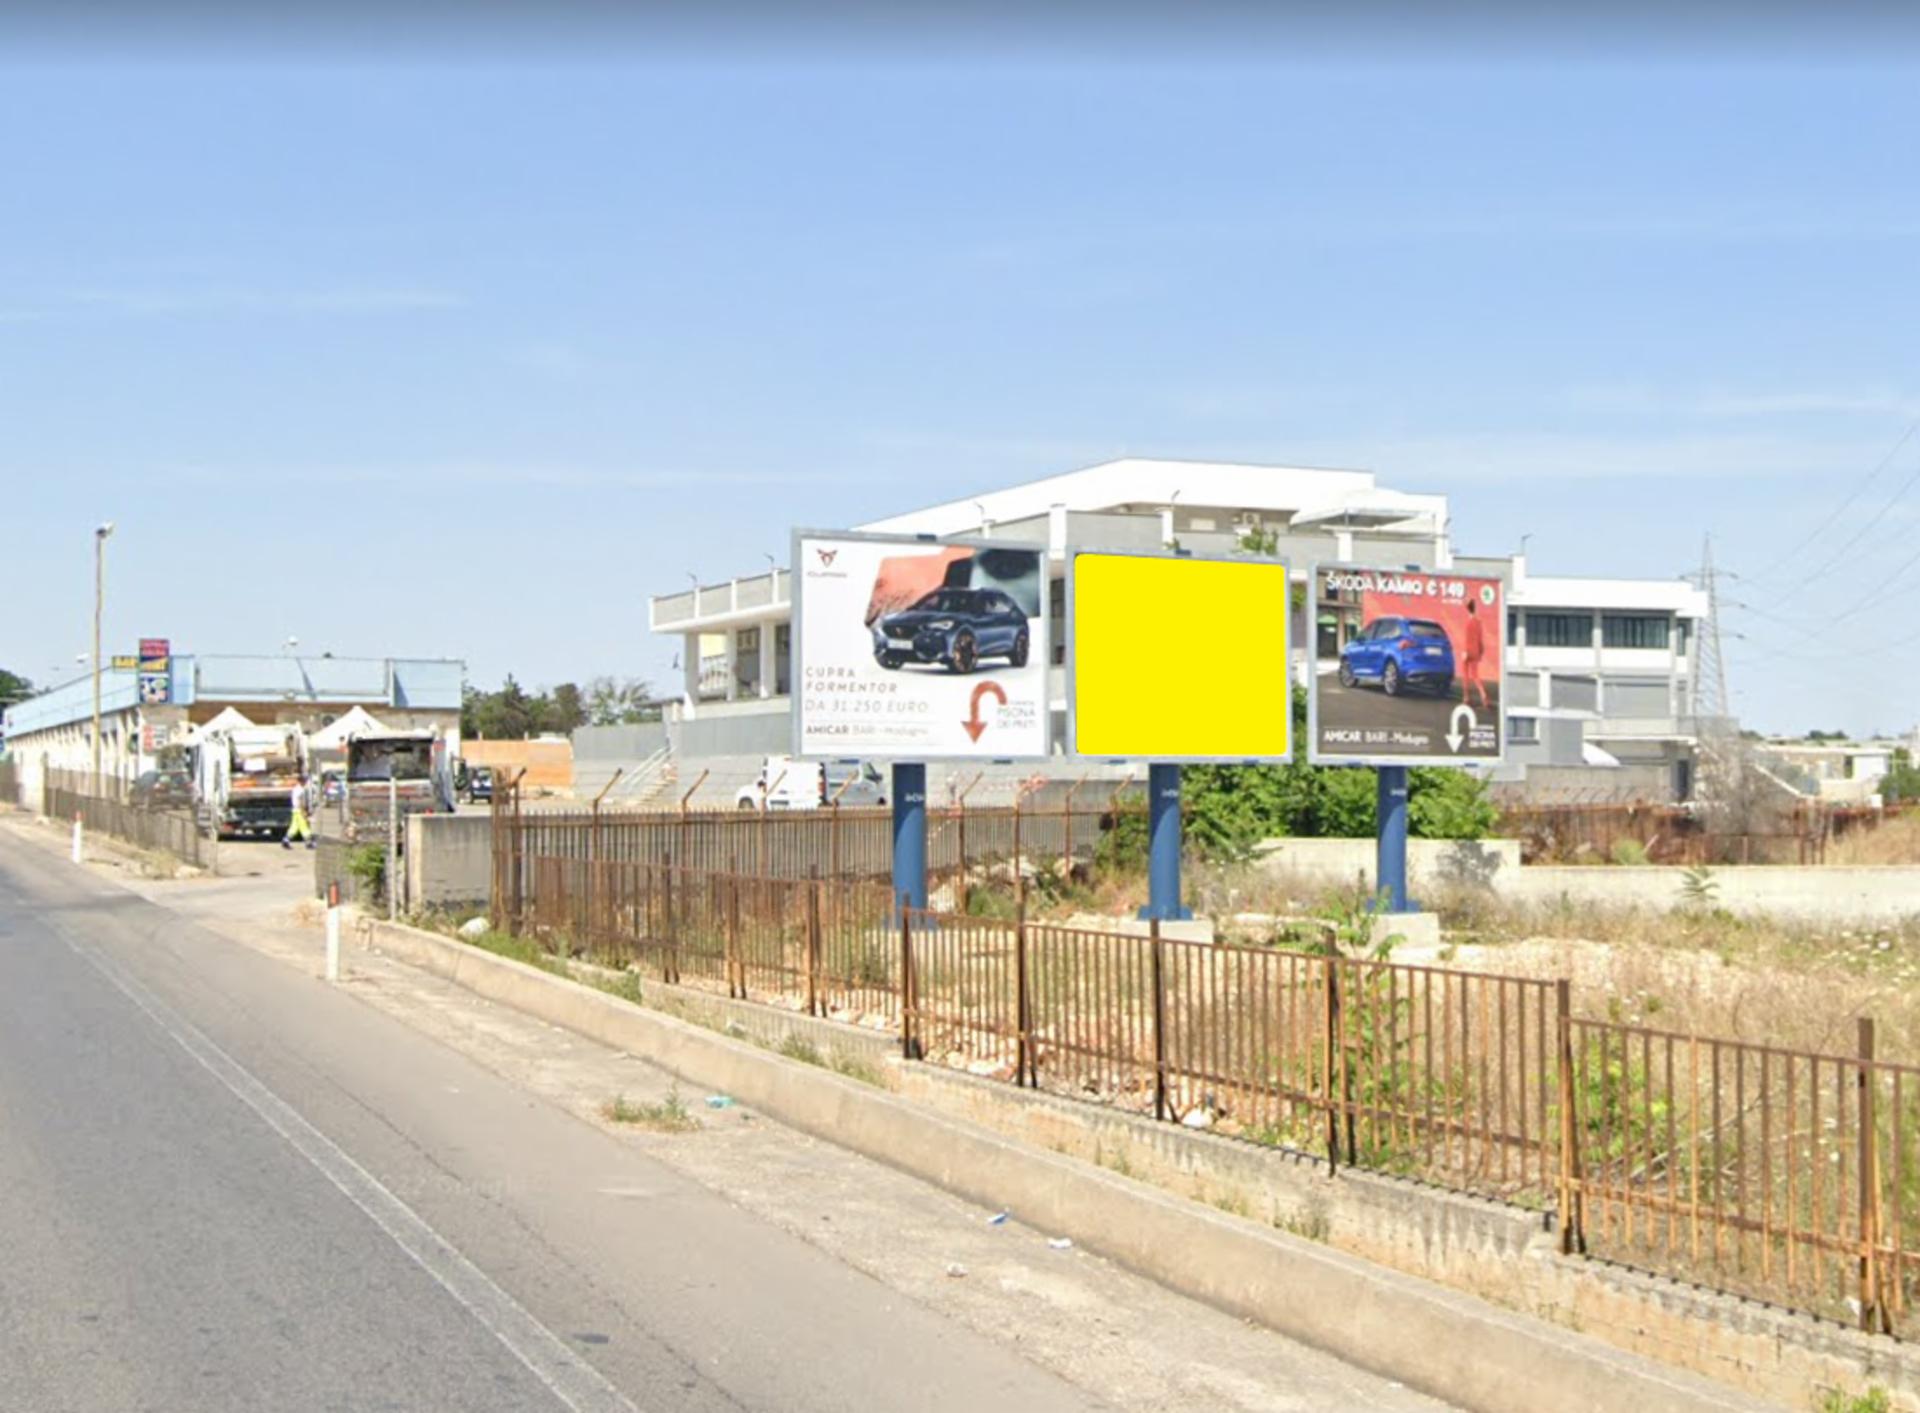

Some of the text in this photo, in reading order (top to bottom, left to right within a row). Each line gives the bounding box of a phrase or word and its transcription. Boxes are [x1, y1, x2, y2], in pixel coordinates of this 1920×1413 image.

[806, 666, 856, 678] CUPRA
[806, 681, 898, 694] FORMENTOR
[805, 699, 825, 712] DA
[887, 700, 929, 713] EURO
[805, 724, 849, 735] AMICAR
[1323, 729, 1362, 743] AMICAR
